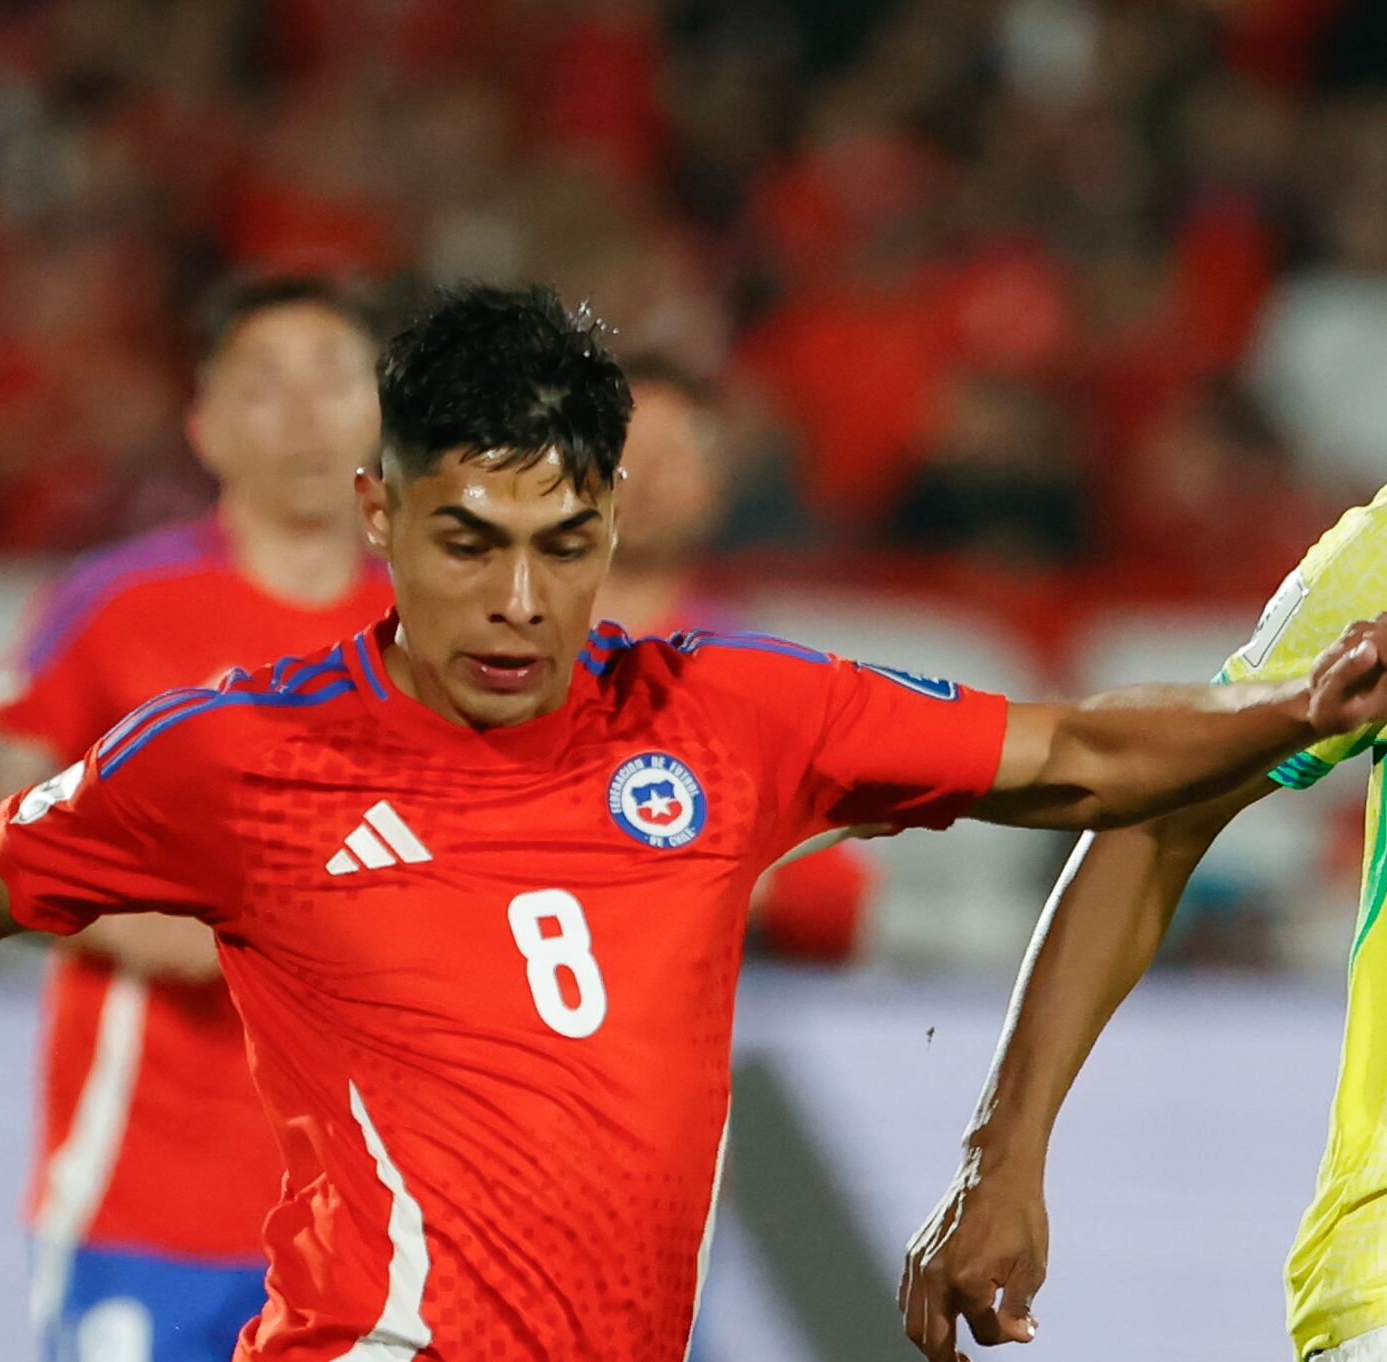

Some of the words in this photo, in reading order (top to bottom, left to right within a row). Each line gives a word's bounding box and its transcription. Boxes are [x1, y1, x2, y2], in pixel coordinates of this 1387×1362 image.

[650, 755, 666, 769] DE
[648, 835, 664, 848] DE
[668, 826, 696, 848] CHILE
[506, 887, 608, 1040] 8
